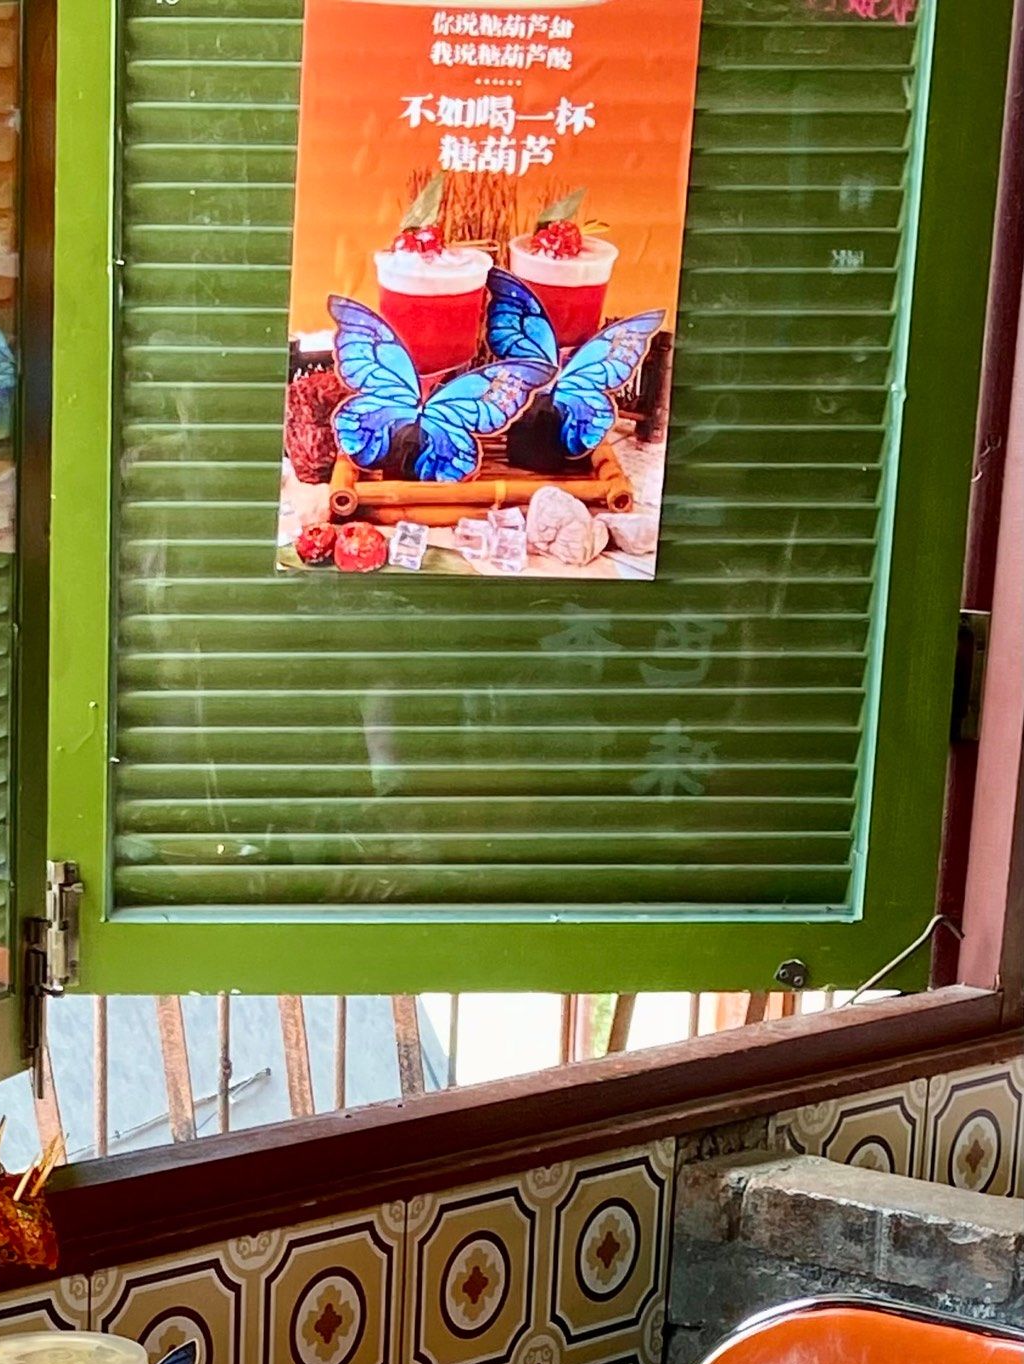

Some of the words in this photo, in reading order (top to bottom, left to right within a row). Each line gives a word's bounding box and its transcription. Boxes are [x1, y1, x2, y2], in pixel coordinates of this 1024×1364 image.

[432, 11, 574, 39] 你说糖葫芦甜
[430, 41, 573, 70] 我说糖葫芦酸
[398, 93, 596, 135] 不如喝一杯
[438, 134, 555, 176] 糖葫芦
